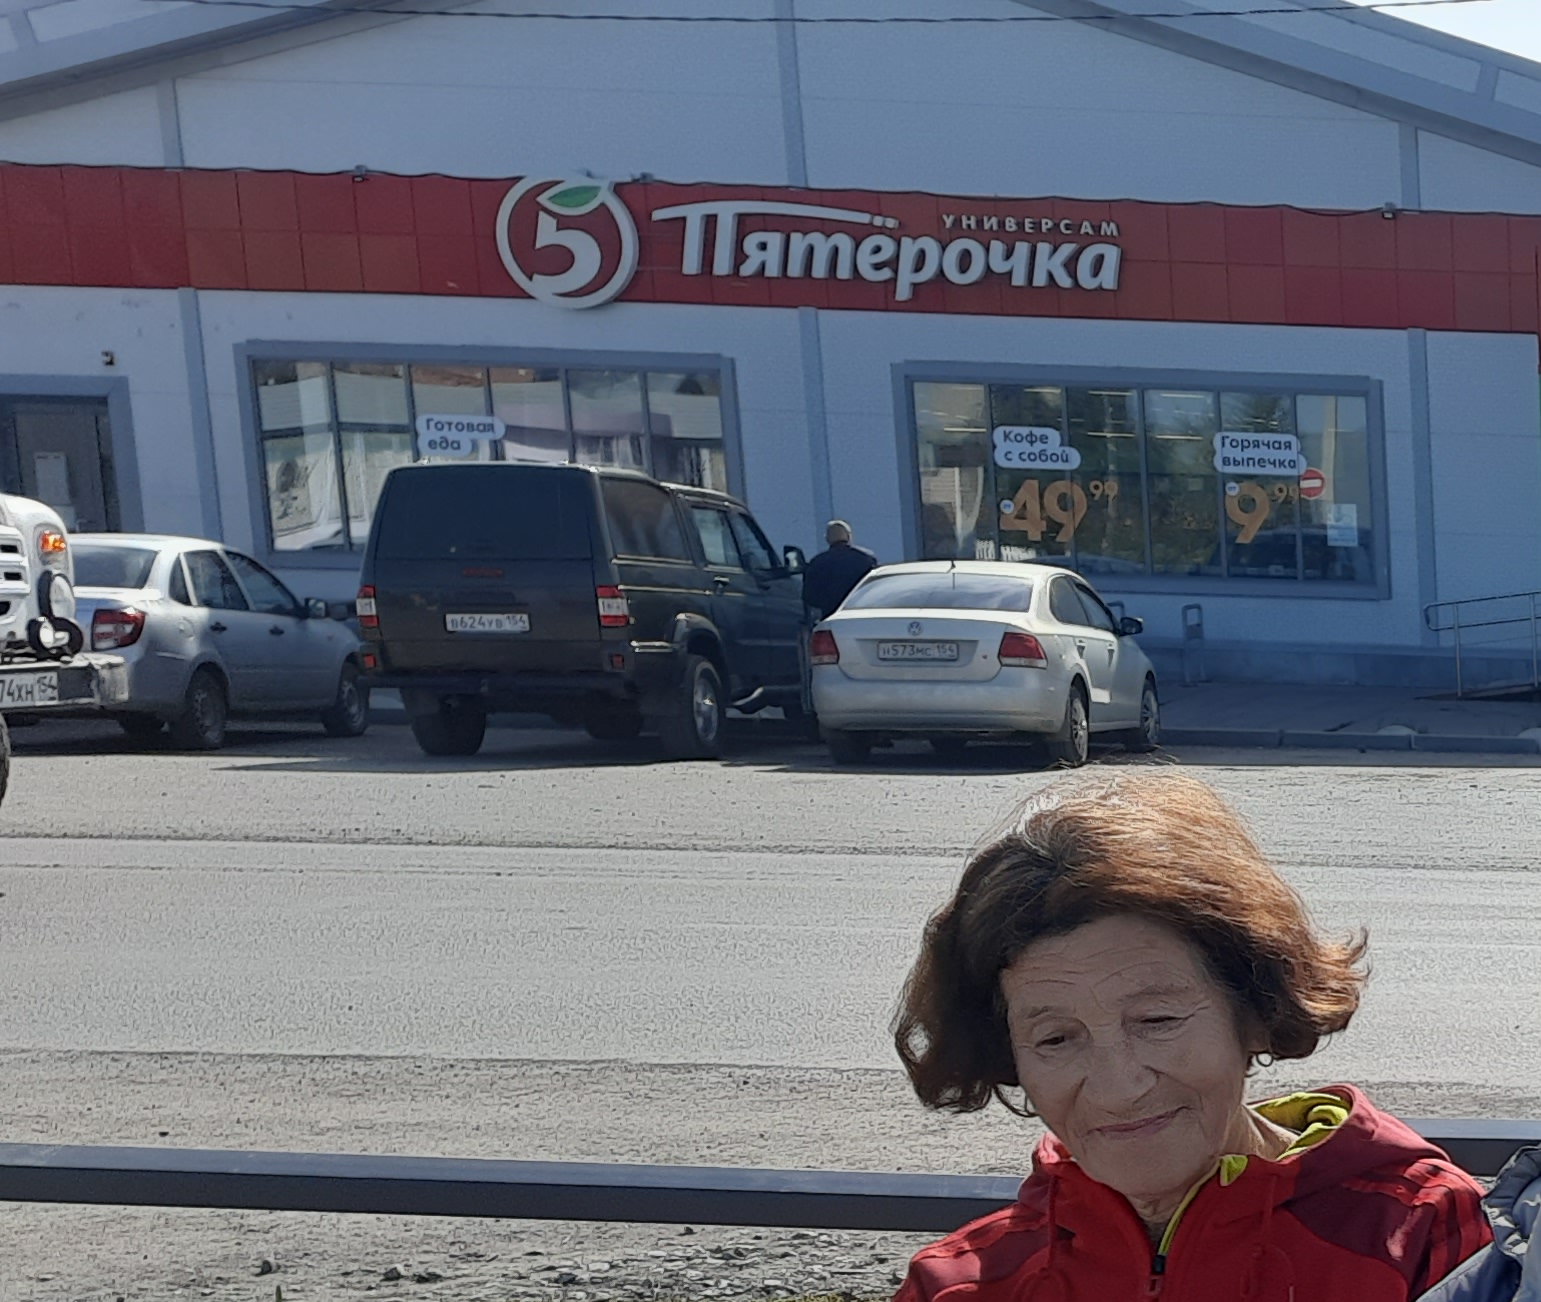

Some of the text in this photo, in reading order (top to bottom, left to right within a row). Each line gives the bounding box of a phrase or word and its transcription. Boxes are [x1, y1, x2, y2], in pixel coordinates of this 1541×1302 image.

[942, 213, 1119, 237] УНИВЕРСАМ
[652, 200, 1121, 300] Пятёрочка
[426, 418, 495, 433] Готовая
[428, 438, 461, 450] еда
[1003, 430, 1049, 447] Кофе
[1221, 436, 1293, 452] Горячая
[1004, 449, 1069, 463] с собой
[1222, 456, 1297, 469] выпечка
[1000, 479, 1087, 542] 49
[1225, 481, 1270, 544] 9
